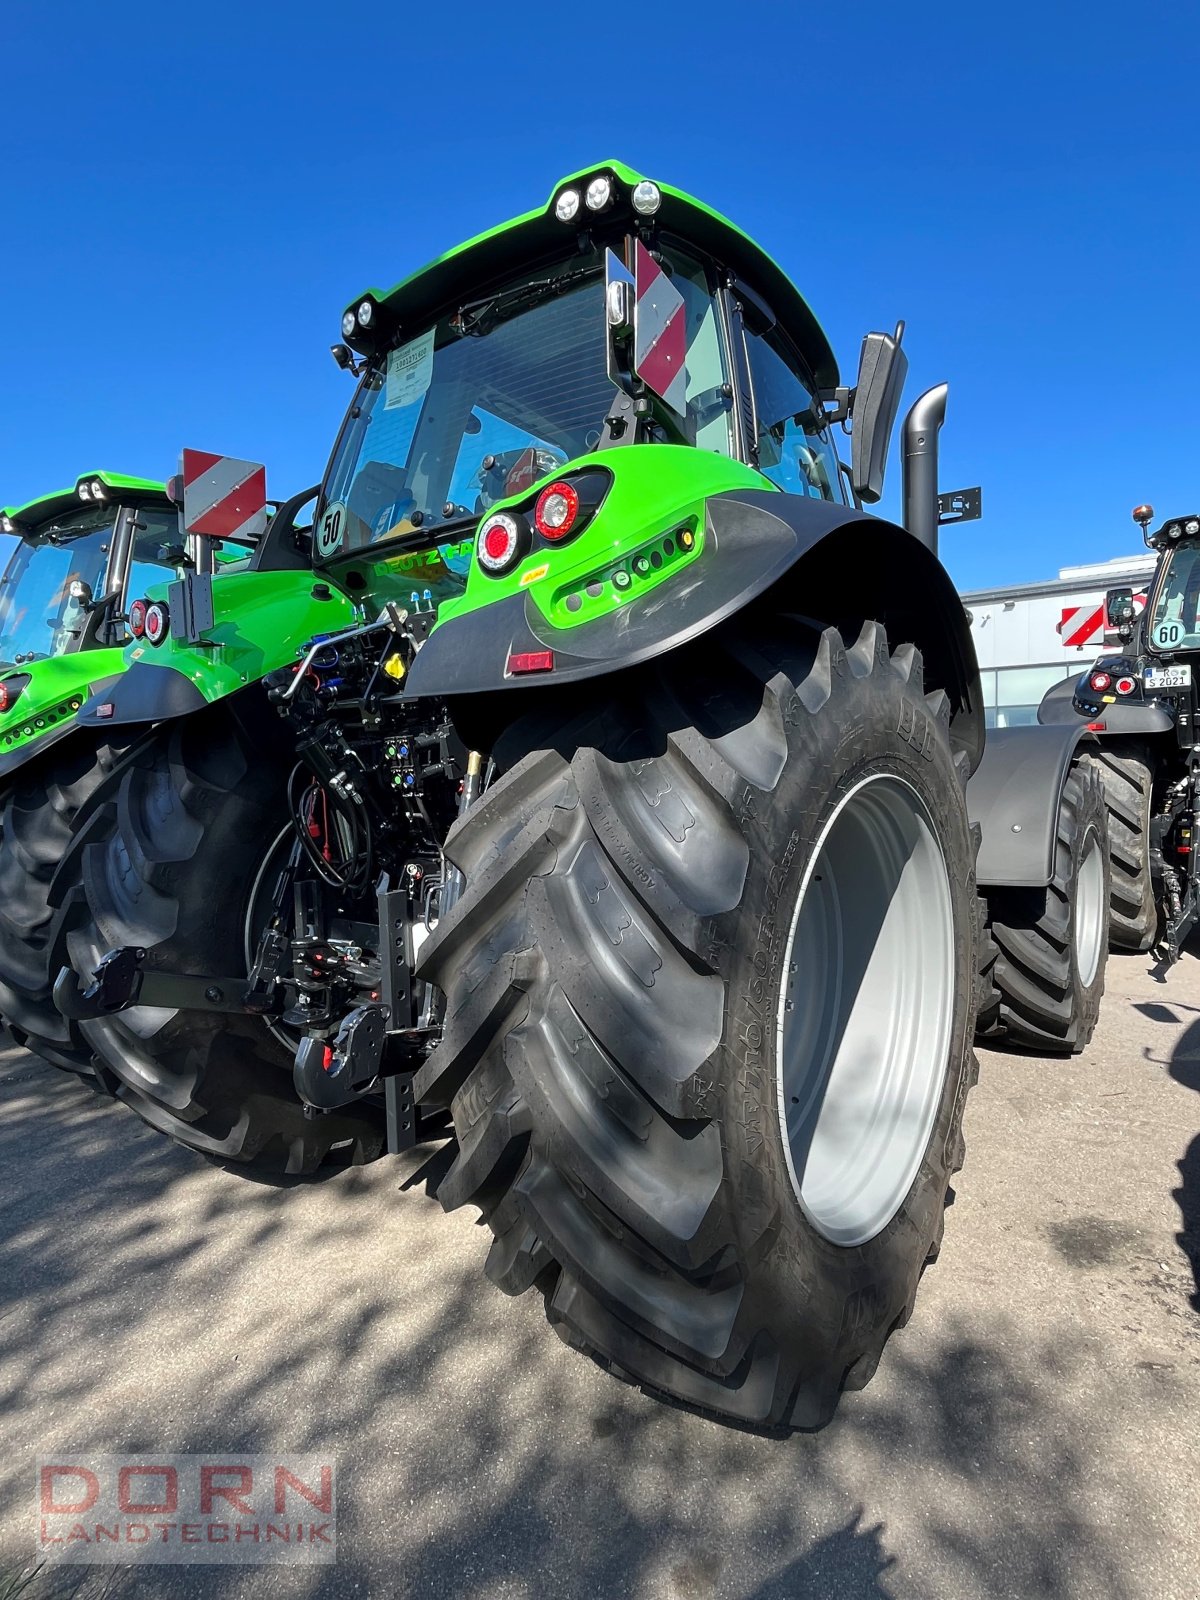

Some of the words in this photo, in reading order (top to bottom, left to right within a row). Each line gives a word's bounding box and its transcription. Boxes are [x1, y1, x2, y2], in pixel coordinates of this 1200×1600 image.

[322, 510, 341, 547] 50
[1160, 625, 1178, 643] 60
[1163, 668, 1170, 678] R
[1149, 678, 1156, 687] S
[1160, 676, 1185, 687] 2021
